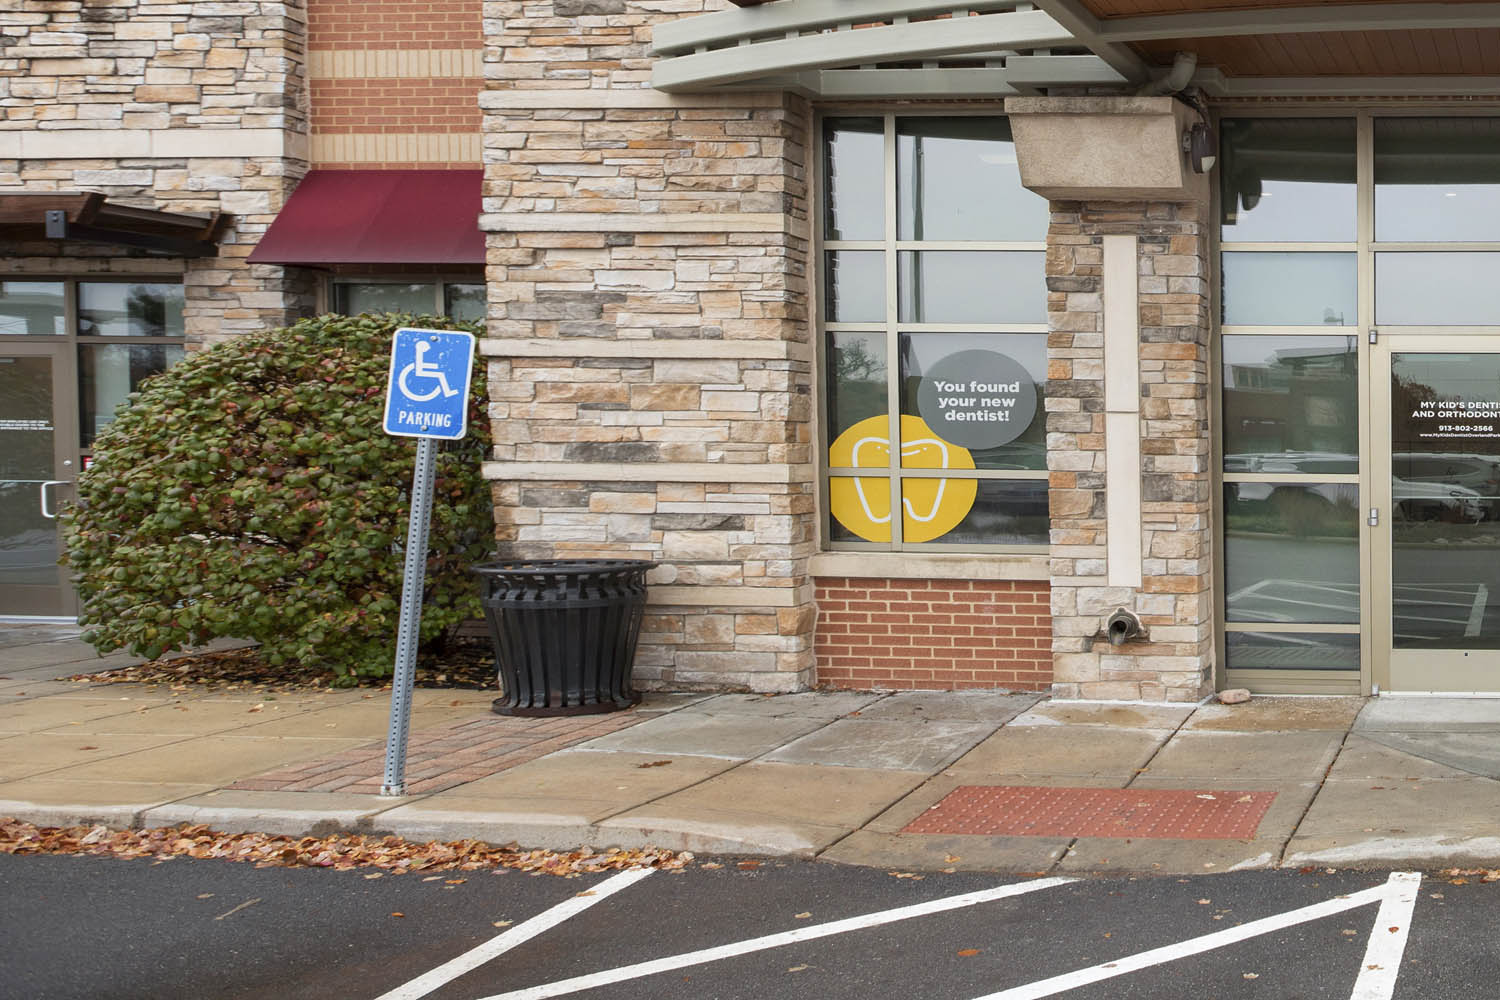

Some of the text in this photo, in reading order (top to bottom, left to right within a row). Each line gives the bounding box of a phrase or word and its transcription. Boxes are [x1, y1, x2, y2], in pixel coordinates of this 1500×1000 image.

[933, 381, 1020, 393] You found
[938, 397, 1016, 409] your new
[1420, 401, 1437, 409] MY
[1438, 401, 1465, 409] KID'S
[398, 410, 452, 428] PARKING
[944, 409, 1010, 421] dentist!
[1412, 410, 1435, 418] AND
